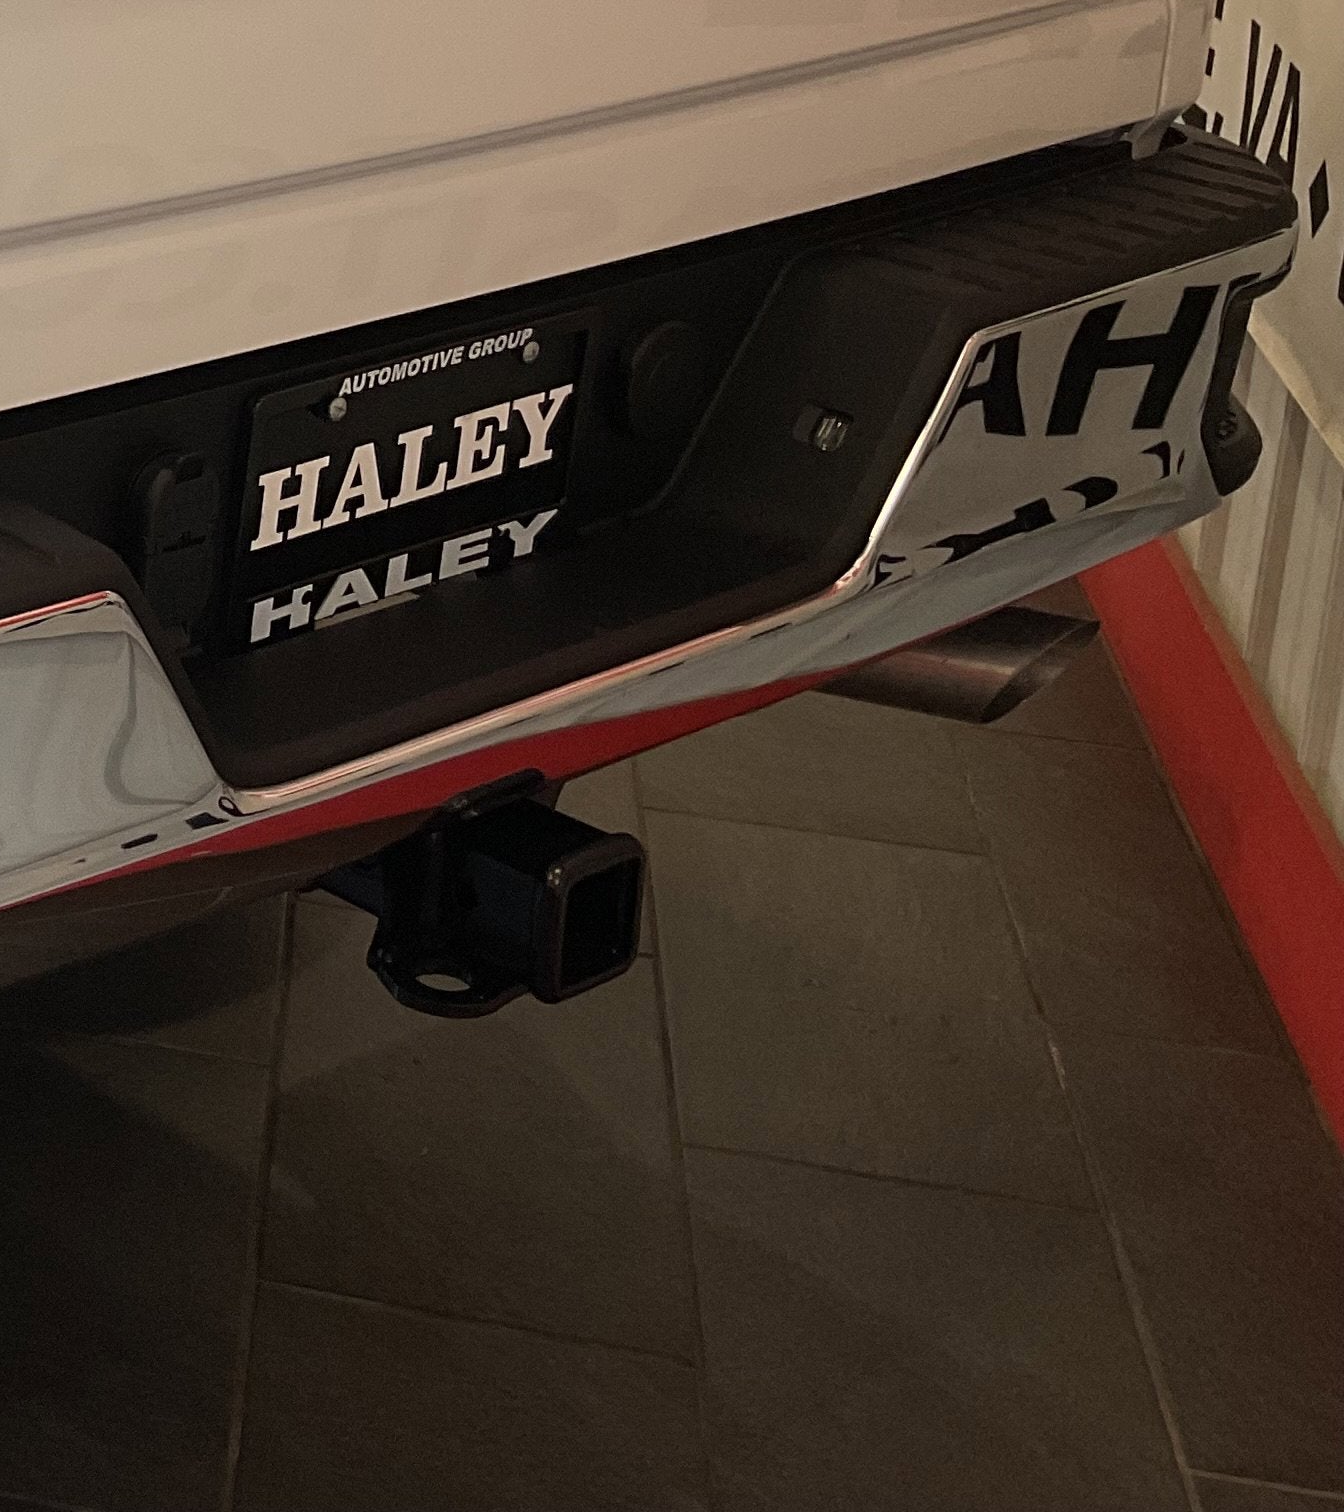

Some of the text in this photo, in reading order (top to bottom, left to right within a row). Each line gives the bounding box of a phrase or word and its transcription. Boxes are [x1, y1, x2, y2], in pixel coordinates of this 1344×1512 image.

[338, 327, 534, 398] AUTOMOTIVE GROUP
[250, 383, 574, 552] HALEY
[250, 508, 559, 644] HALEY
